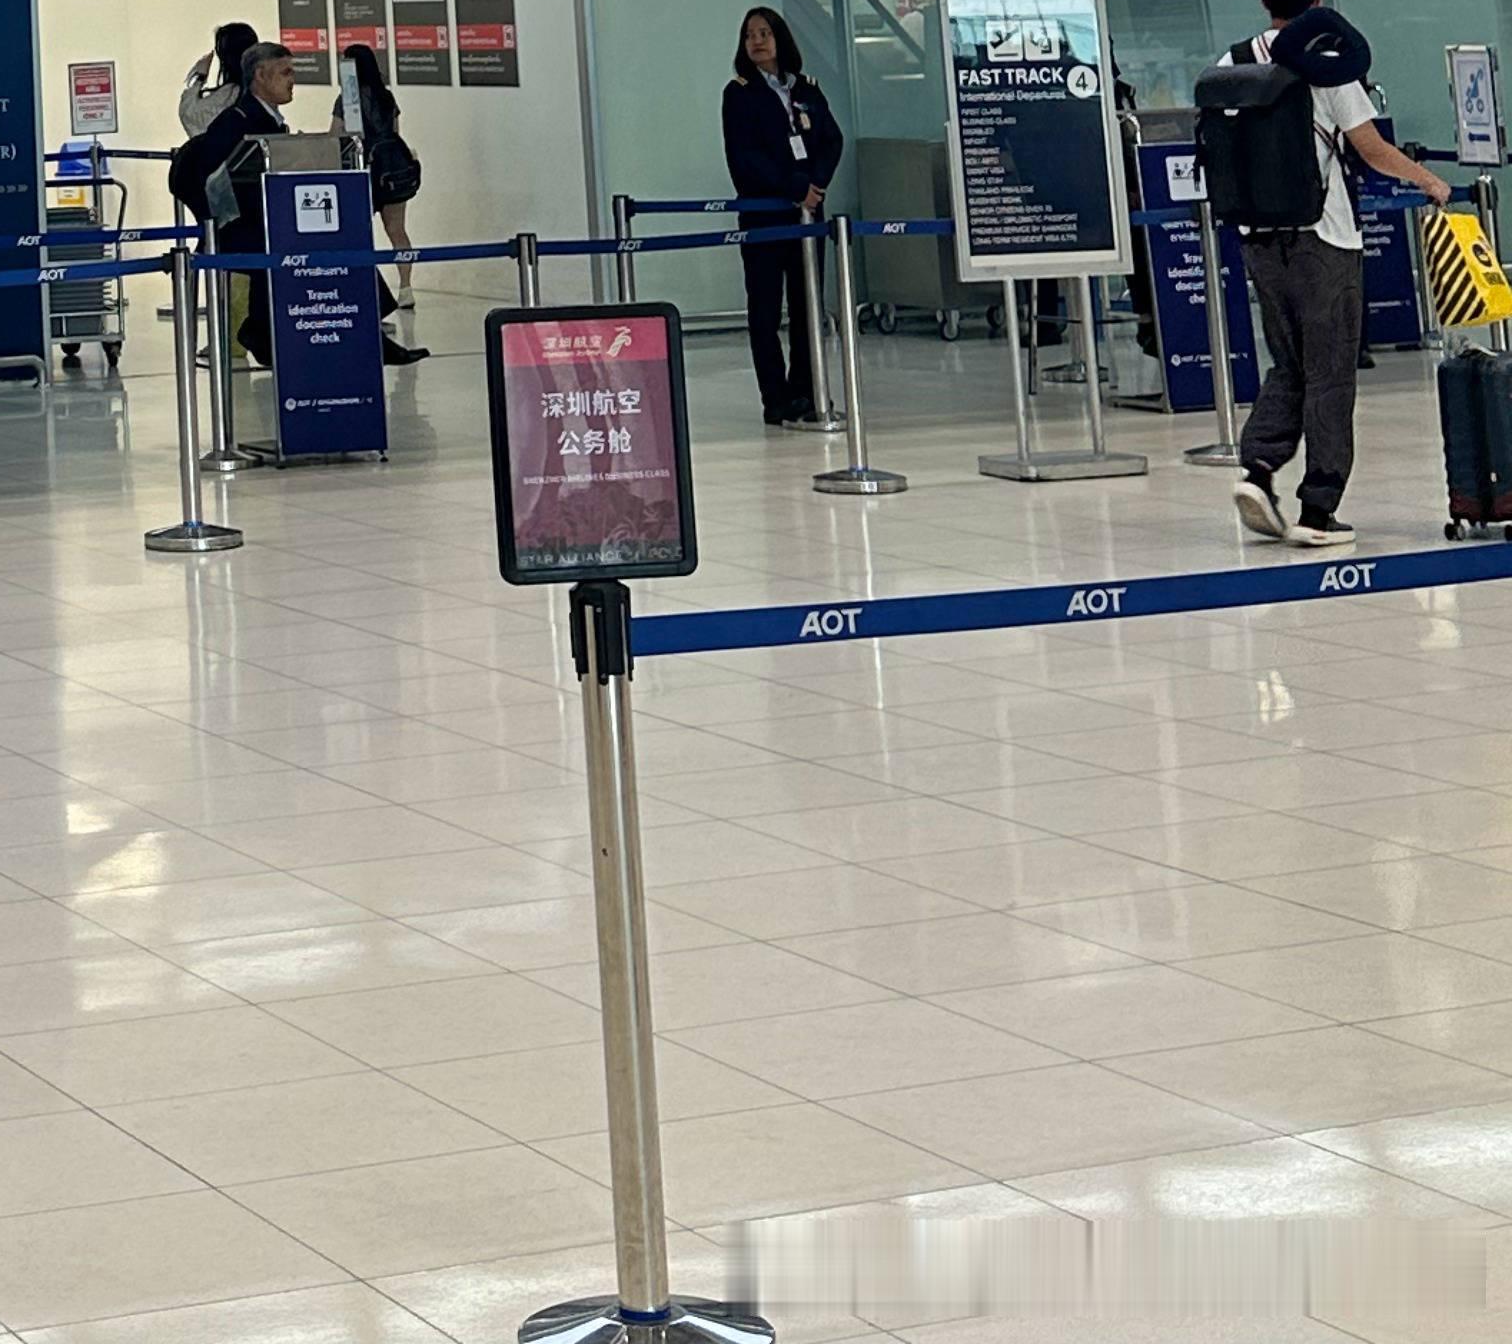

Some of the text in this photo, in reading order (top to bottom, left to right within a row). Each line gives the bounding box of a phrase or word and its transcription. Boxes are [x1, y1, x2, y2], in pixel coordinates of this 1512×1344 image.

[958, 67, 1088, 90] FAST TRACK 4
[16, 235, 42, 247] AOT
[281, 254, 309, 267] AOT
[393, 250, 421, 262] AOT
[37, 268, 67, 281] AOT
[306, 289, 339, 300] Travel
[288, 303, 358, 316] identification
[295, 318, 353, 330] documents
[310, 332, 340, 344] check
[541, 389, 642, 419] 深圳航空
[557, 427, 632, 456] 公务舱
[1319, 563, 1376, 592] AOT
[1066, 587, 1127, 616] AOT
[800, 608, 862, 637] AOT
